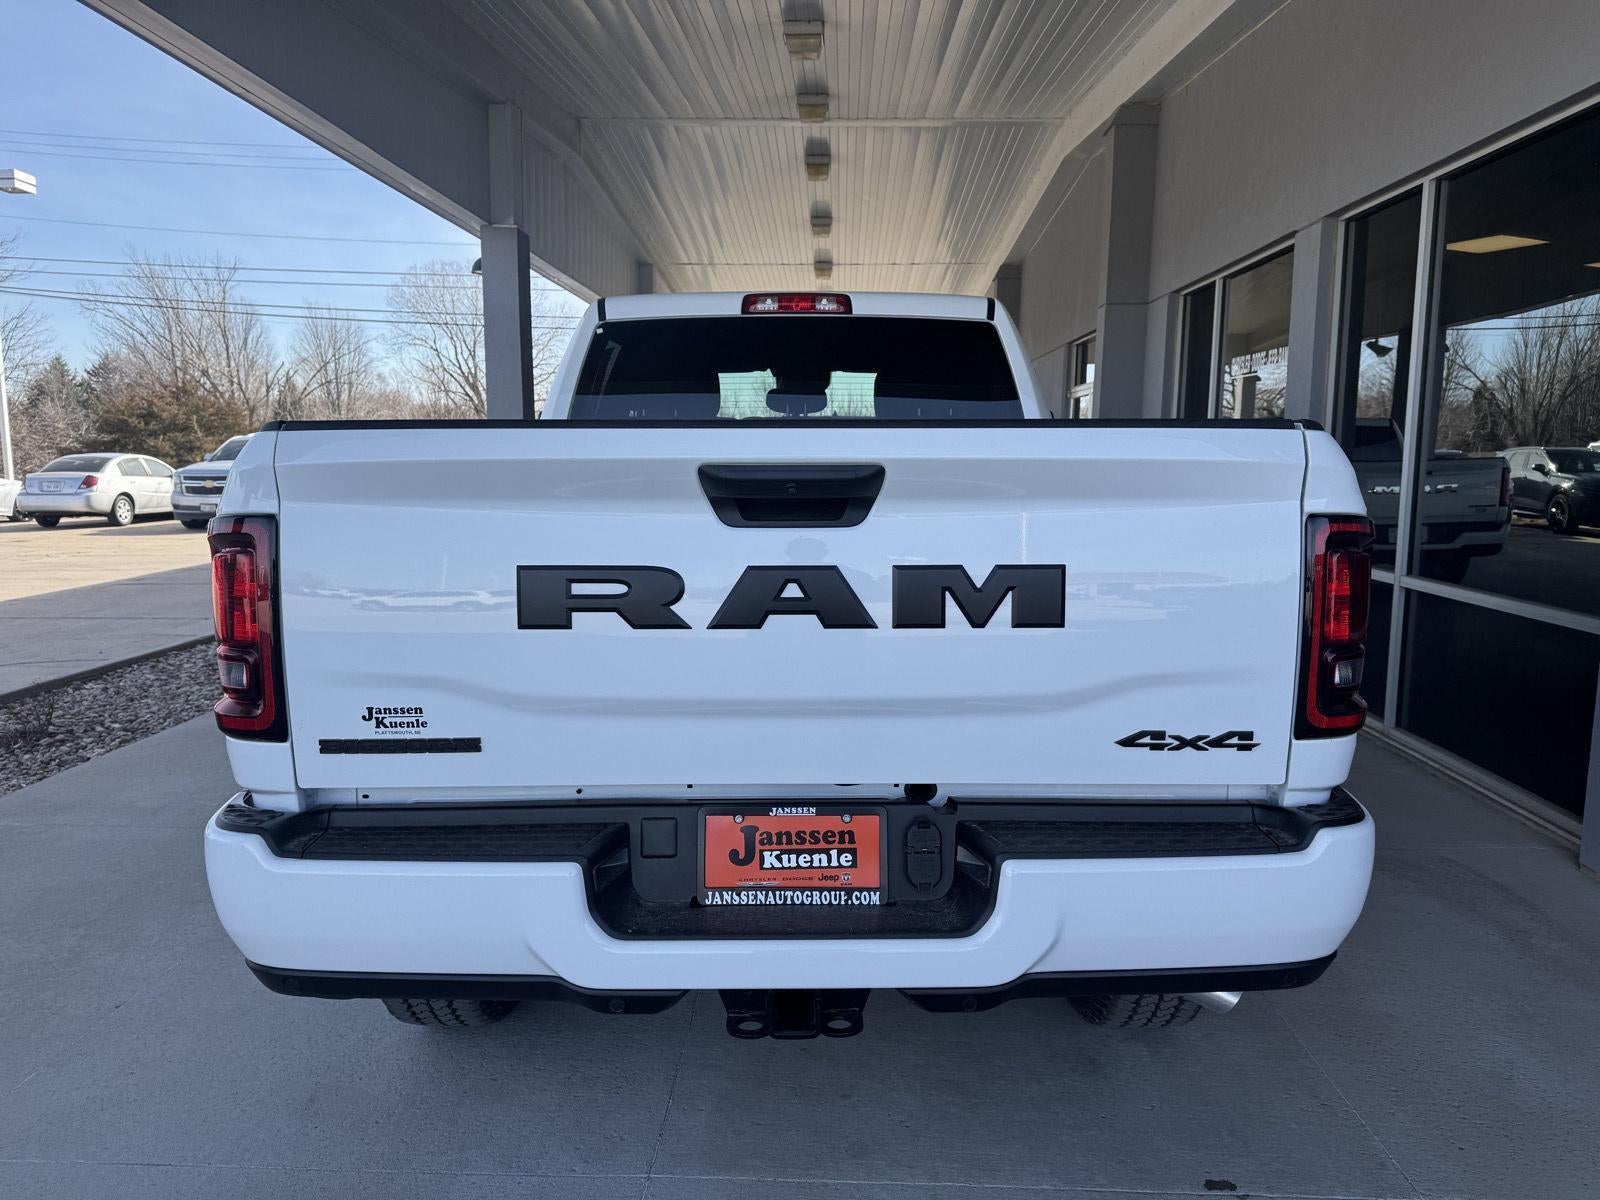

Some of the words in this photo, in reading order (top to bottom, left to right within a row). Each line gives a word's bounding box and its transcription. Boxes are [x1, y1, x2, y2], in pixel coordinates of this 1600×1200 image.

[516, 564, 1066, 630] RAM
[362, 706, 424, 721] Janssen
[374, 716, 428, 729] Kuenle
[1114, 730, 1261, 752] 4x4
[769, 807, 816, 816] JANSSEN
[728, 825, 857, 866] Janssen
[762, 849, 853, 868] Kuenle
[818, 873, 840, 882] Jeep
[705, 890, 881, 905] JANSSENAUTOGROUP.COM
